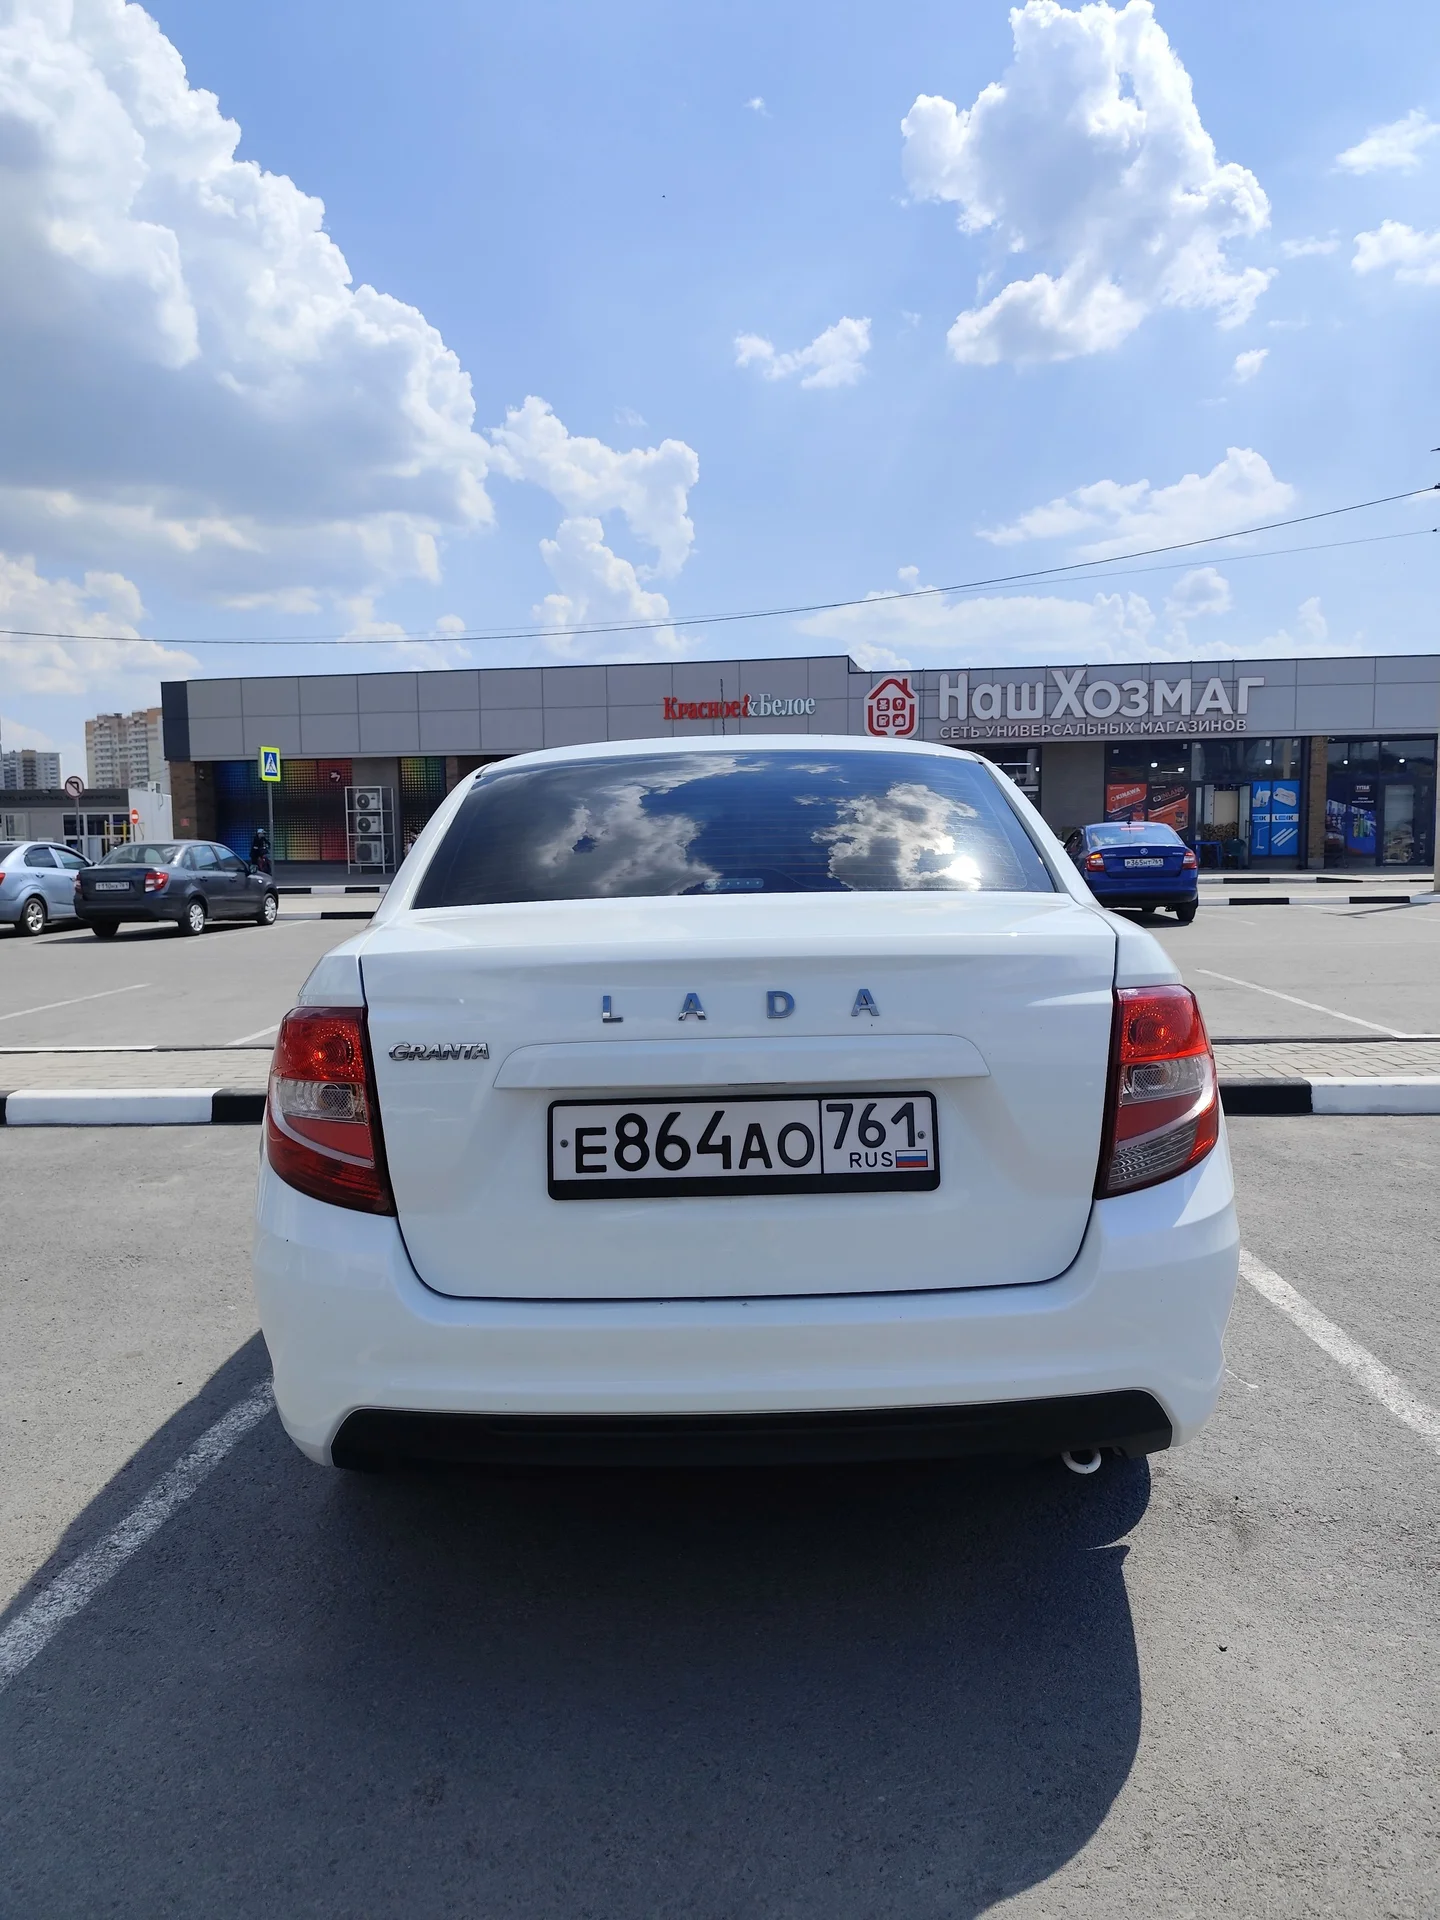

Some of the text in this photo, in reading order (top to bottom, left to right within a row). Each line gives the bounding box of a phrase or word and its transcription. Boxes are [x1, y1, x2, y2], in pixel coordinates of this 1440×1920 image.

[939, 719, 1247, 739] СЕТЬ УНИВЕРСАЛЬНЫХ МАГАЗИНОВ
[602, 988, 880, 1024] LADA
[388, 1042, 490, 1061] GRANTA
[575, 1102, 916, 1174] Е864АО 761
[849, 1151, 894, 1168] RUS
